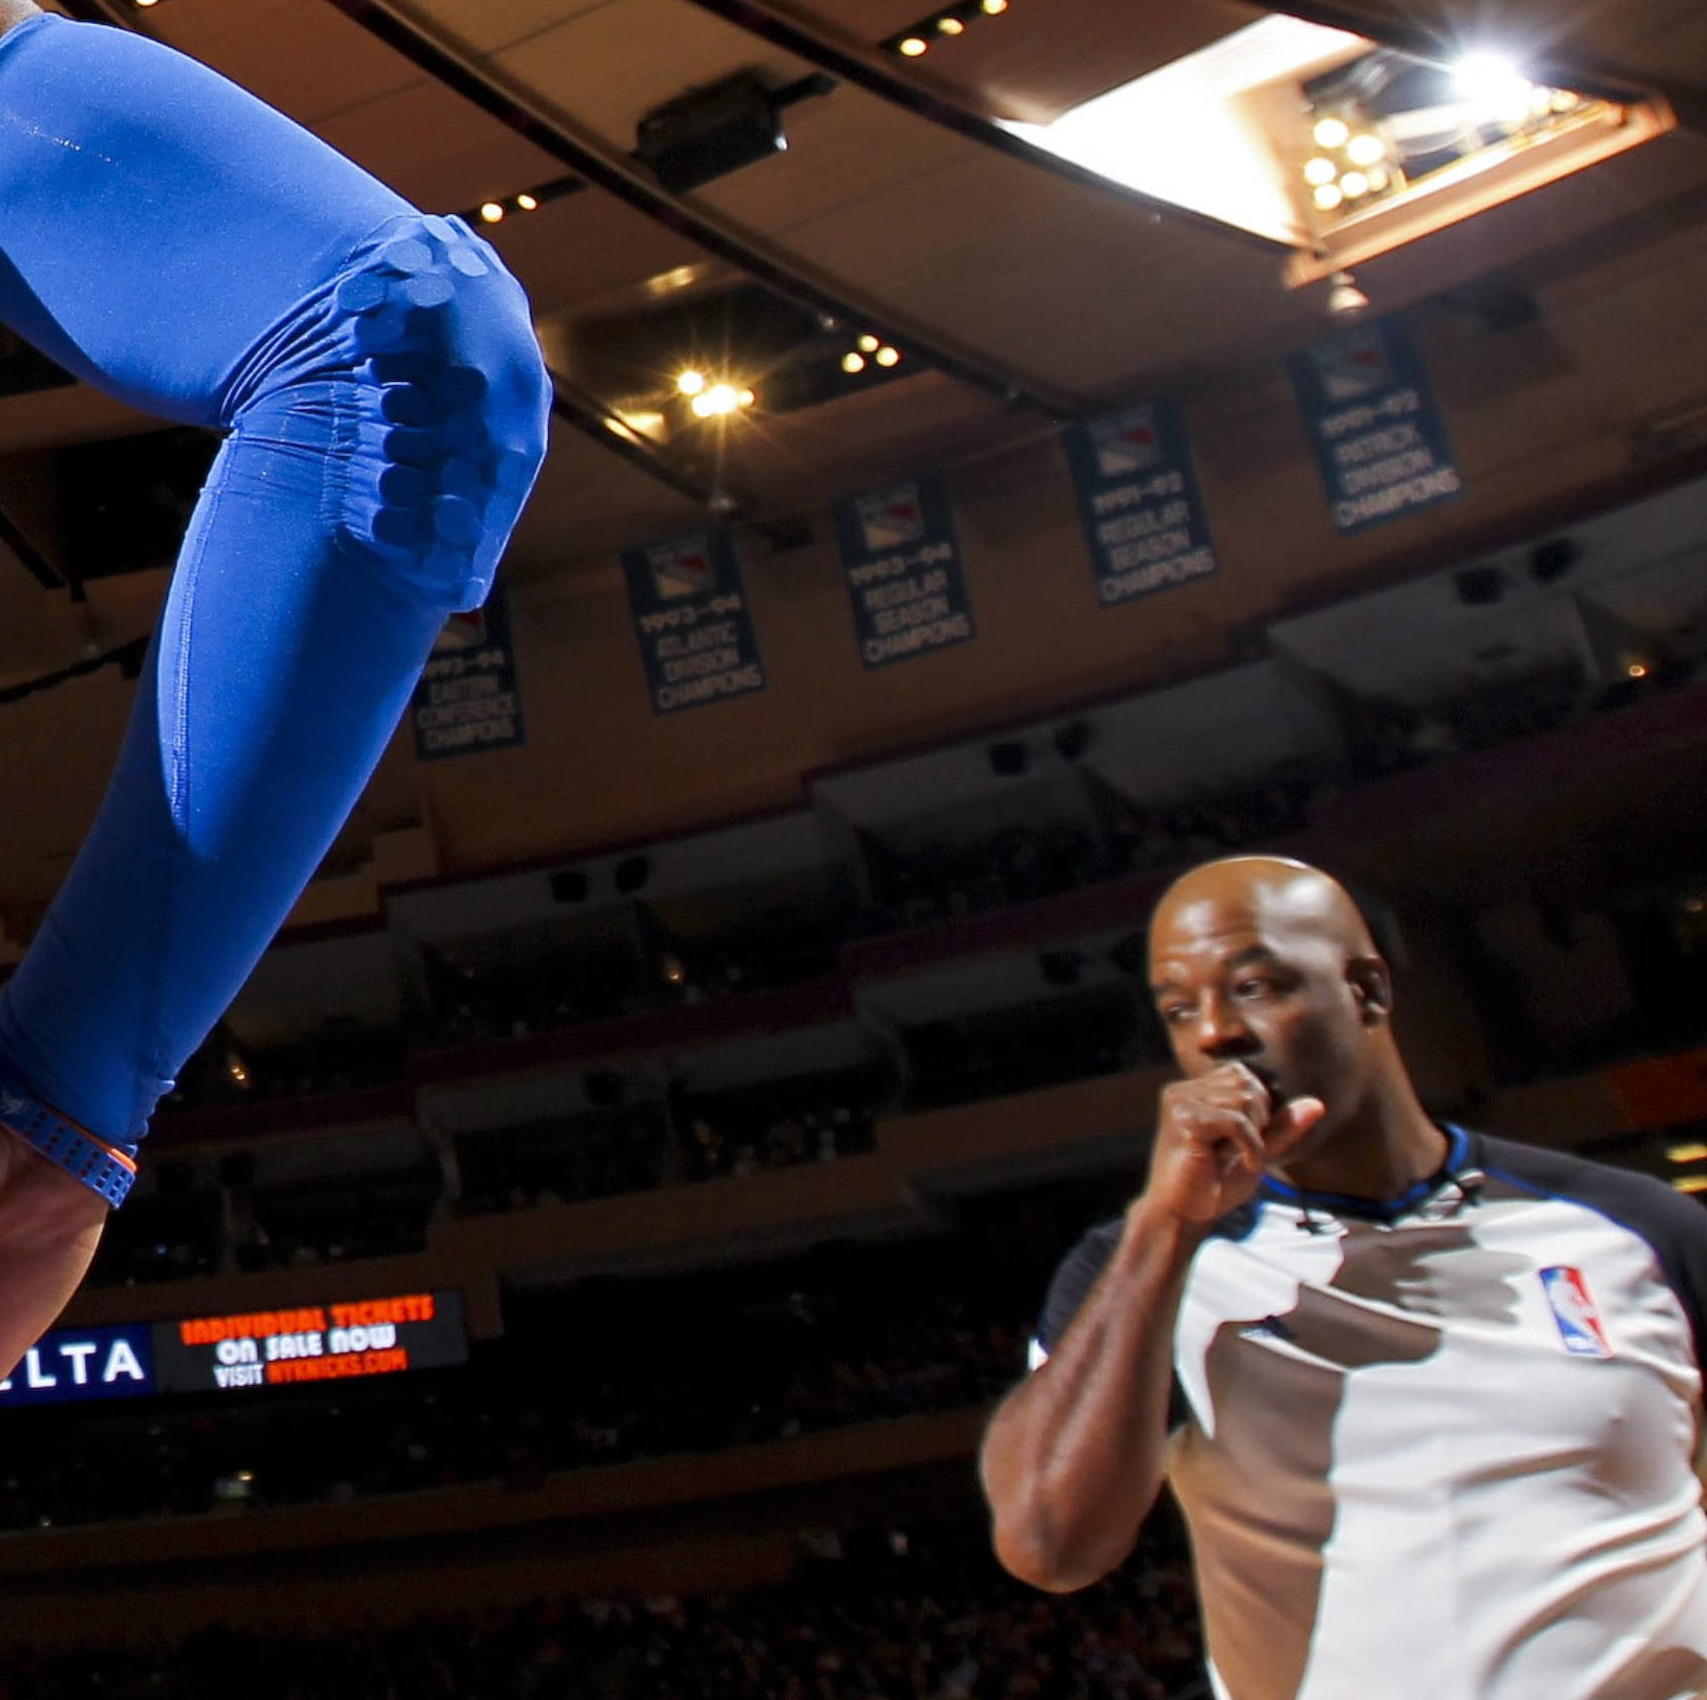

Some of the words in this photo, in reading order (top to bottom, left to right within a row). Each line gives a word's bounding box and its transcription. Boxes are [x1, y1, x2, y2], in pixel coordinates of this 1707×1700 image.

[1337, 466, 1462, 528] CHAMPIONS
[1101, 546, 1216, 601] CHAMPIONS
[863, 613, 972, 661] CHAMPIONS
[656, 664, 764, 710] CHAMPIONS
[329, 1294, 435, 1328] TICKETS
[265, 1331, 323, 1361] SALE
[213, 1363, 265, 1389] VISIT
